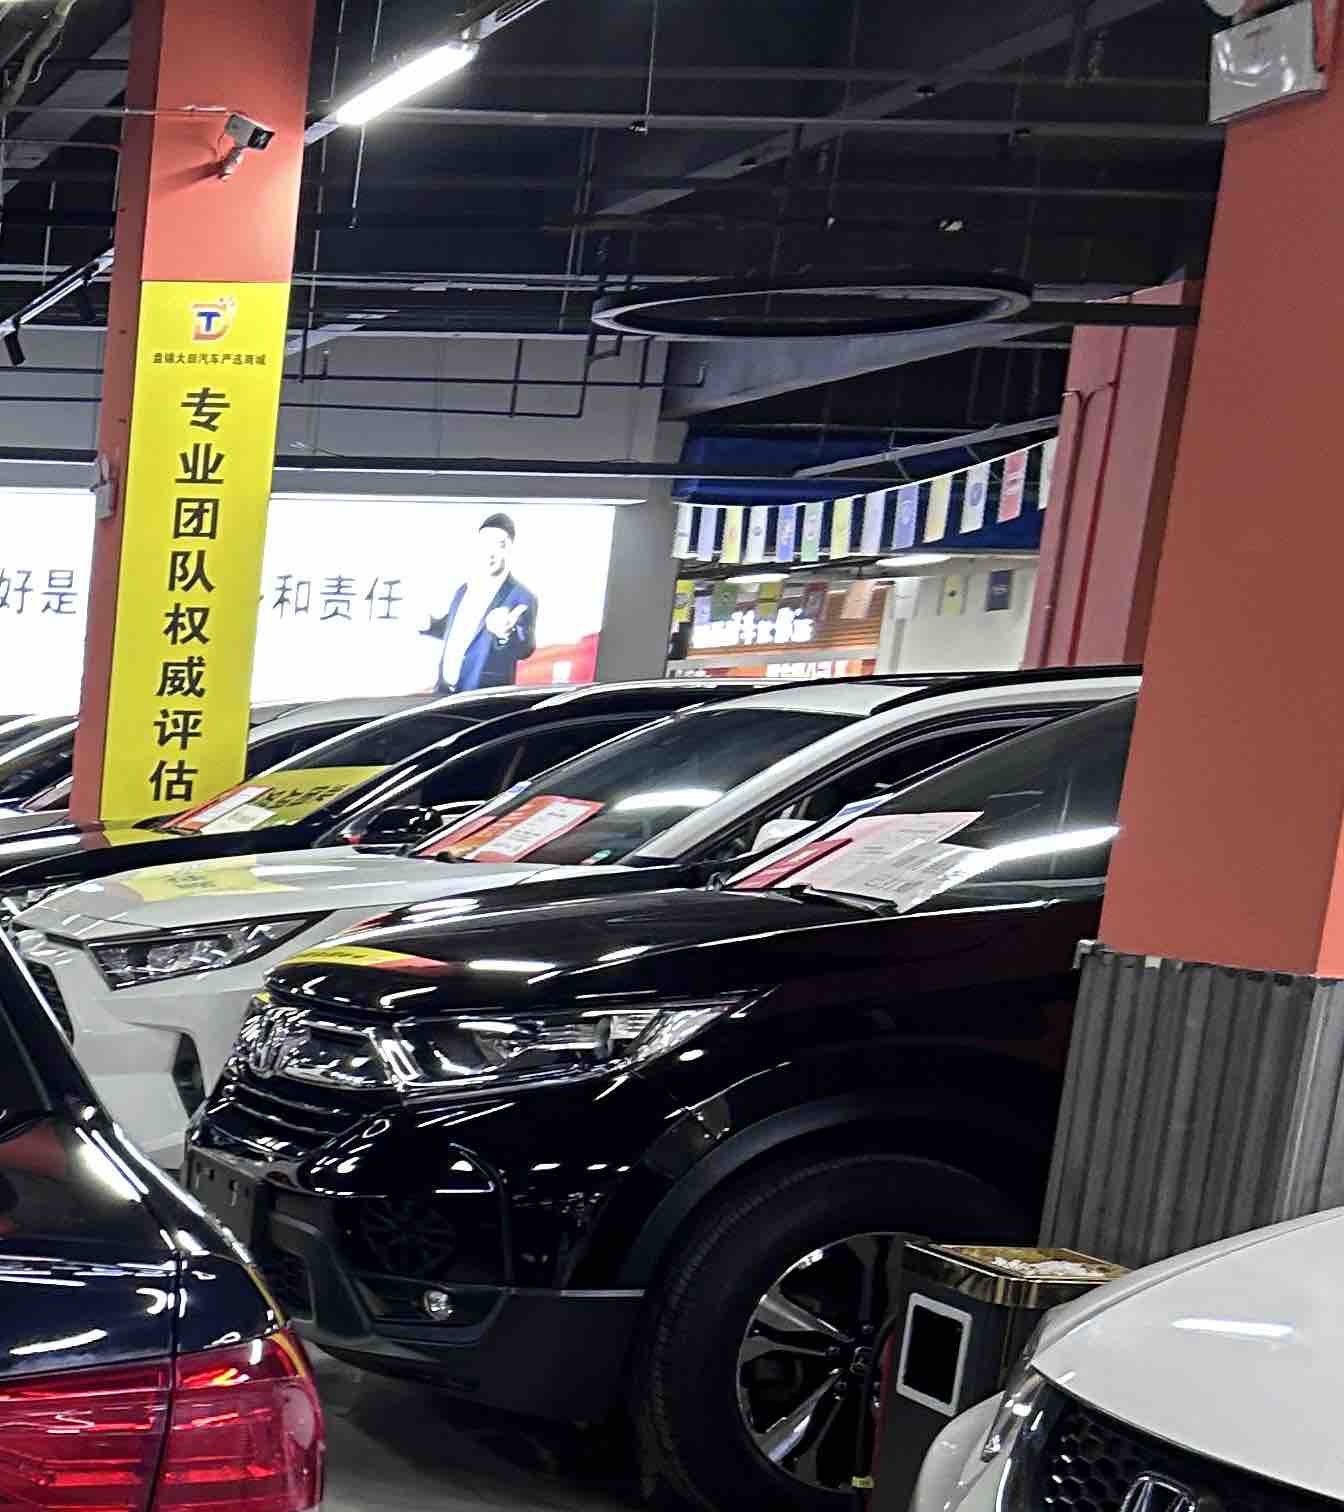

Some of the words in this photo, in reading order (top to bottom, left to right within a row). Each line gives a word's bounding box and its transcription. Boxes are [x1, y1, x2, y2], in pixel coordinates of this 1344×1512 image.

[148, 387, 231, 803] 专业团队权威评估
[272, 574, 404, 622] 和责任
